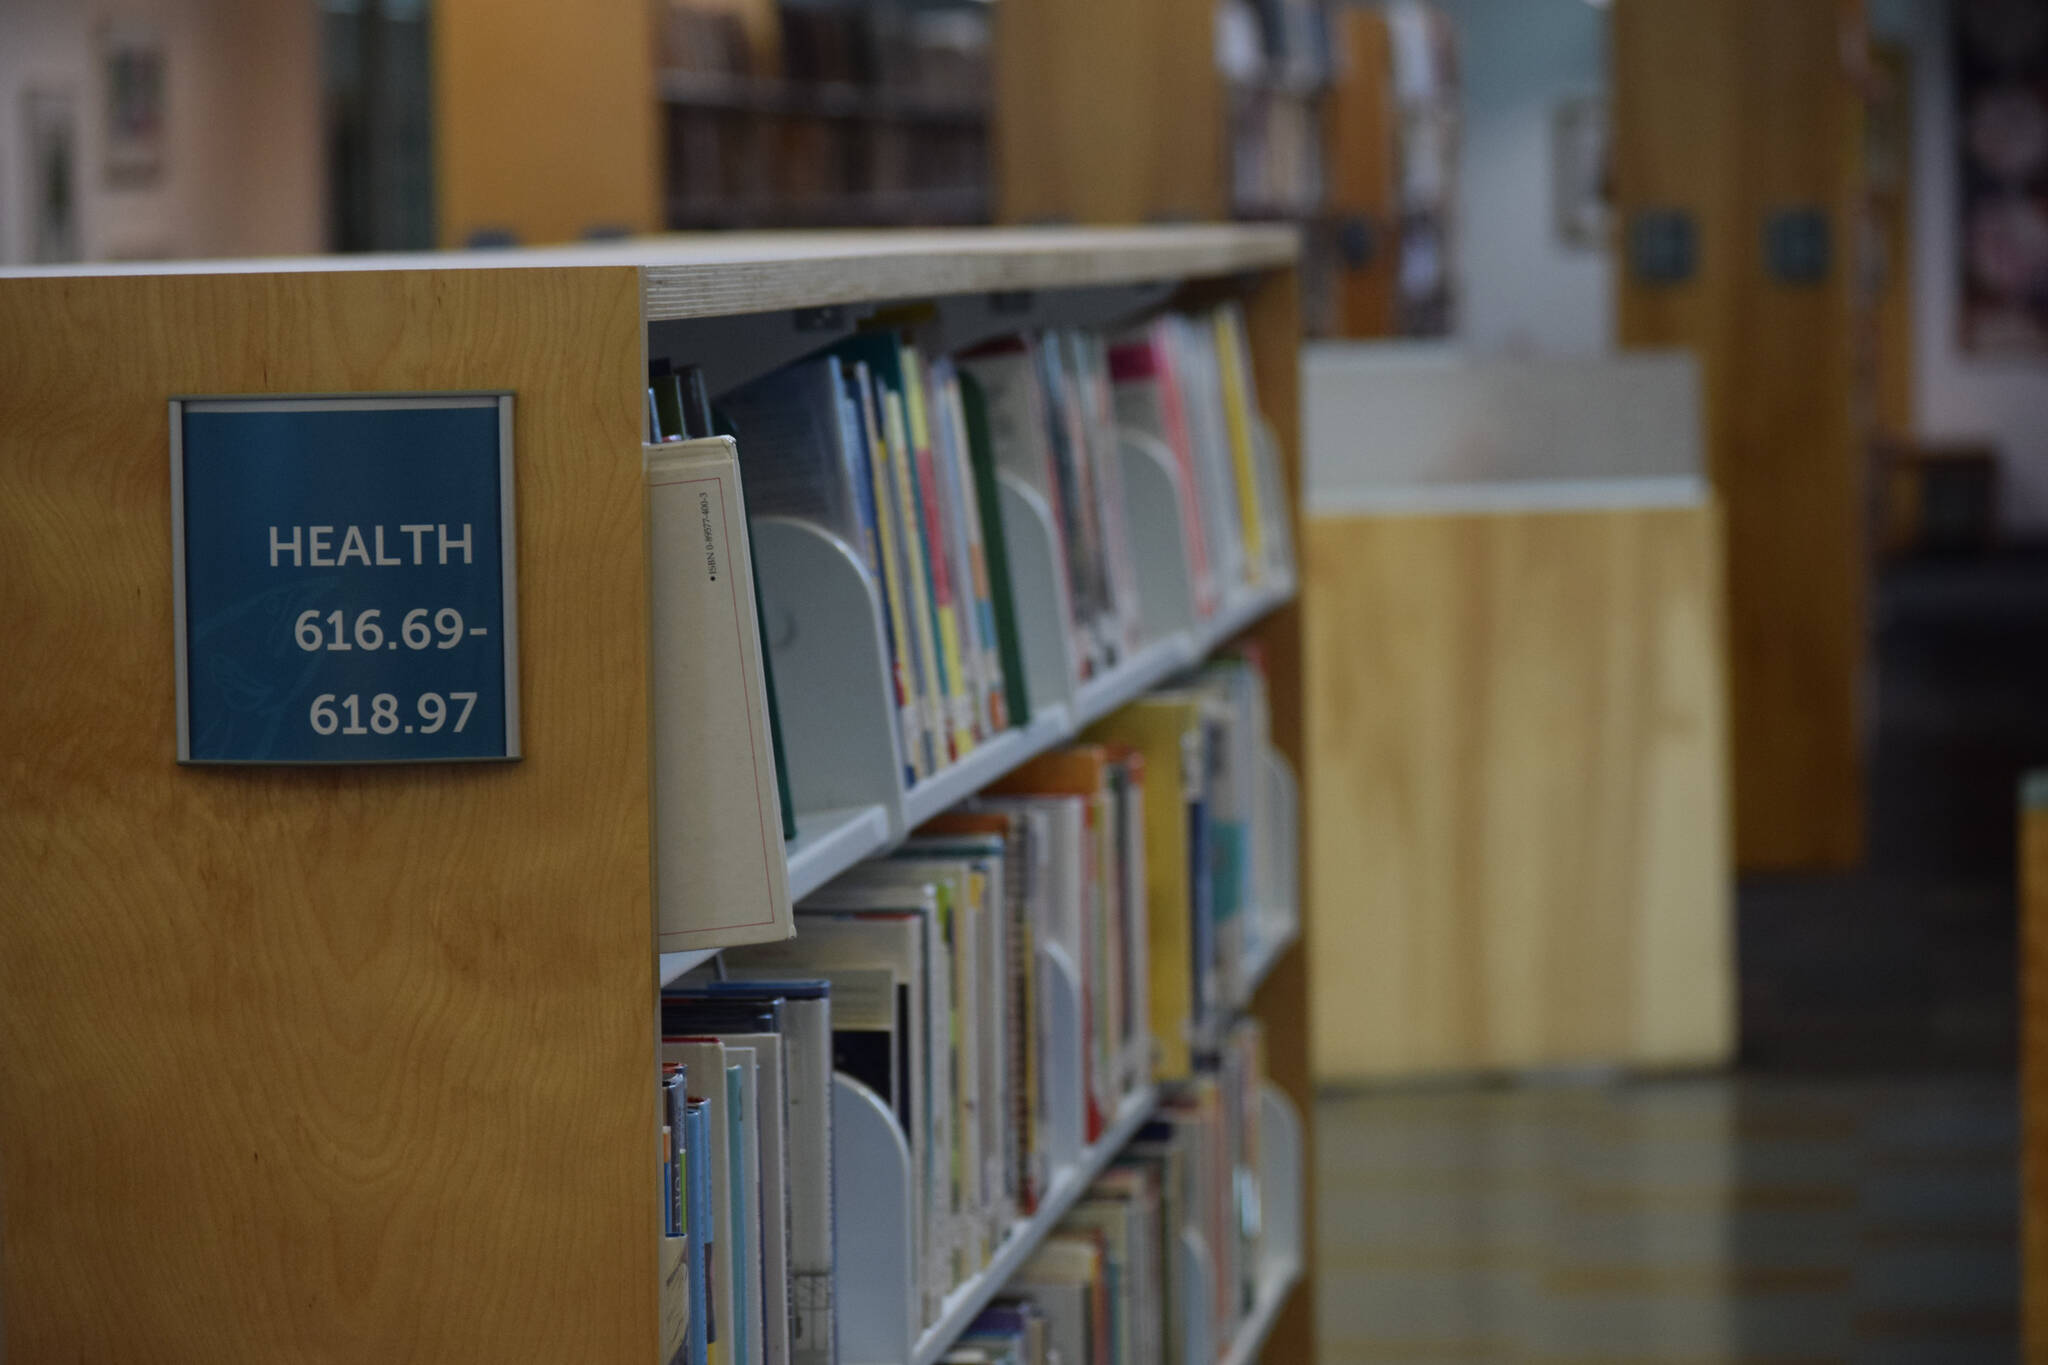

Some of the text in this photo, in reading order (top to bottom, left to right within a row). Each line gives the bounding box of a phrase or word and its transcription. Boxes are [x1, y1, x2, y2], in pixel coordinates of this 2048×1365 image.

[269, 524, 472, 567] HEALTH
[706, 552, 717, 575] ISBN
[294, 608, 488, 651] 616.69-
[310, 692, 478, 735] 618.97
